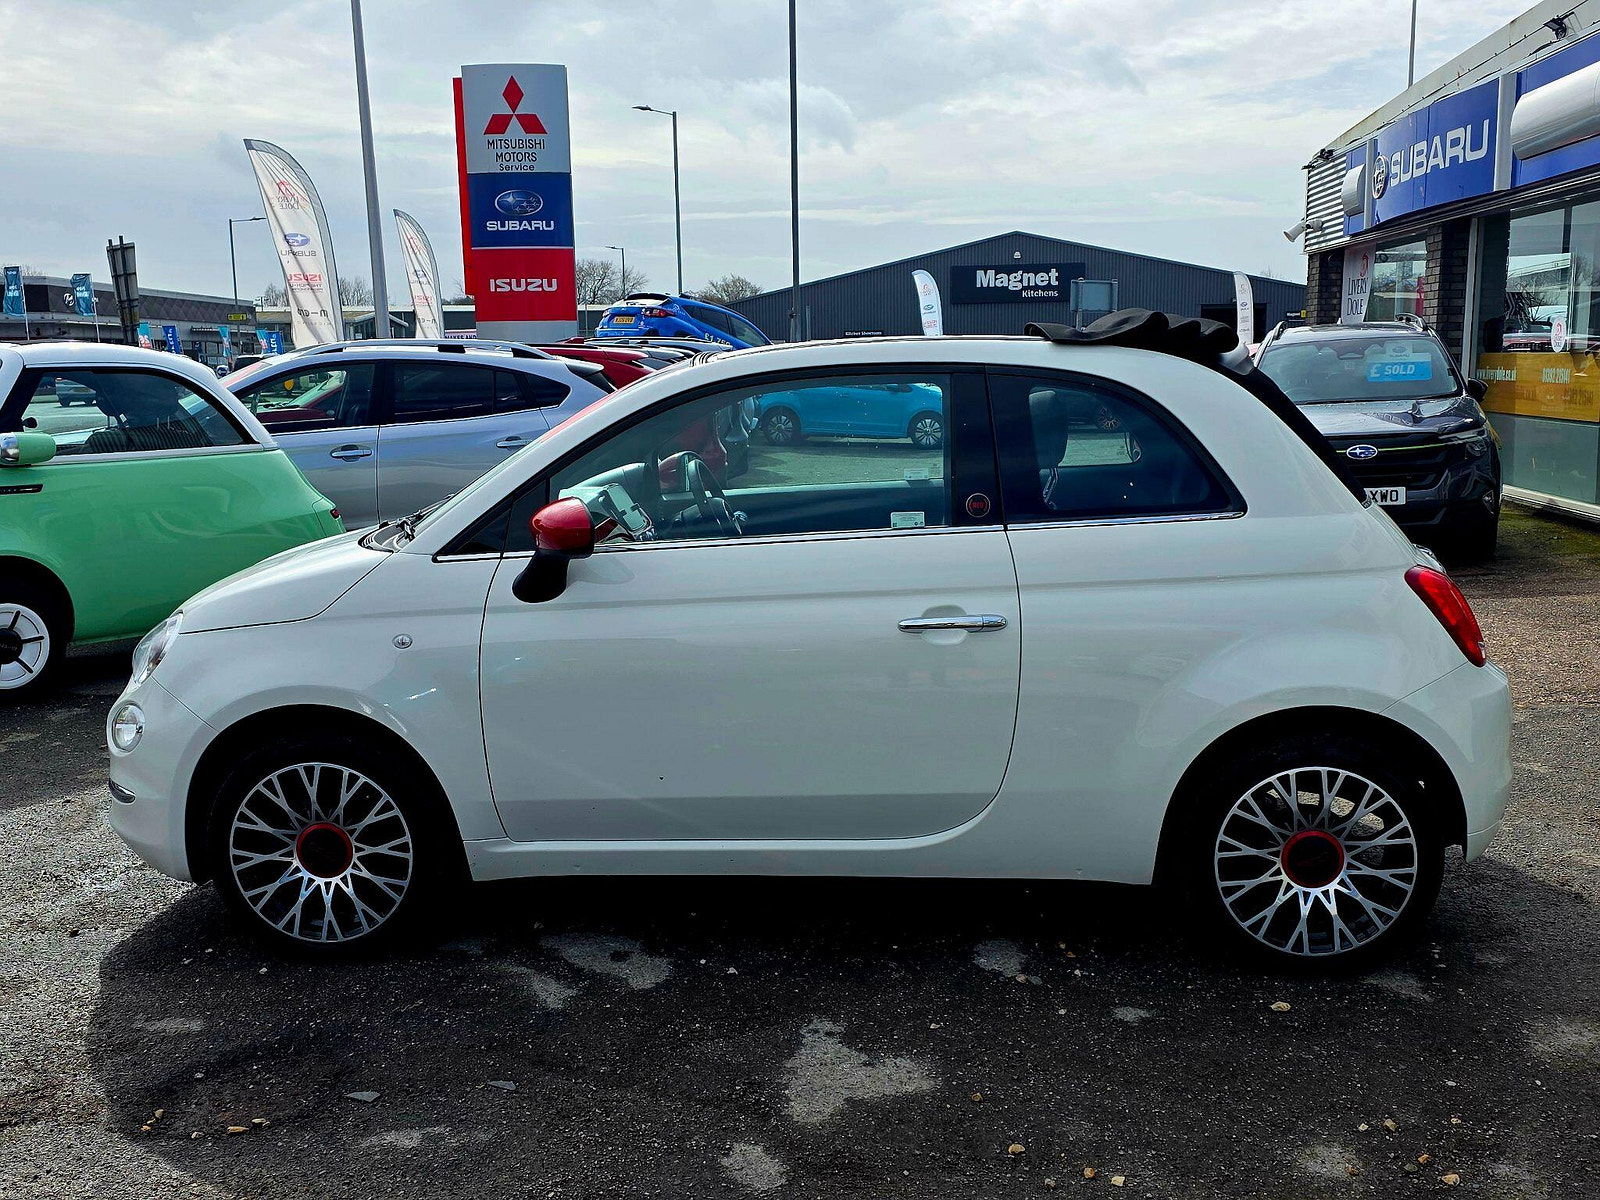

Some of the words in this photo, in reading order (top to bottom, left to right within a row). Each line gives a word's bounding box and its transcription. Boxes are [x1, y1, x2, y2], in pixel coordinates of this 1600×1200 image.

[487, 138, 546, 150] MITSUBISHI
[495, 151, 538, 163] MOTORS
[1389, 119, 1489, 187] SUBARU
[499, 163, 536, 172] Service
[486, 220, 555, 231] SUBARU
[489, 278, 559, 292] ISUZU
[976, 268, 1059, 291] Magnet
[1022, 288, 1059, 298] Kitchens
[1347, 277, 1369, 296] LIVERY
[1346, 297, 1364, 315] DOLE
[1384, 364, 1415, 375] SOLD
[1370, 489, 1399, 503] XWO
